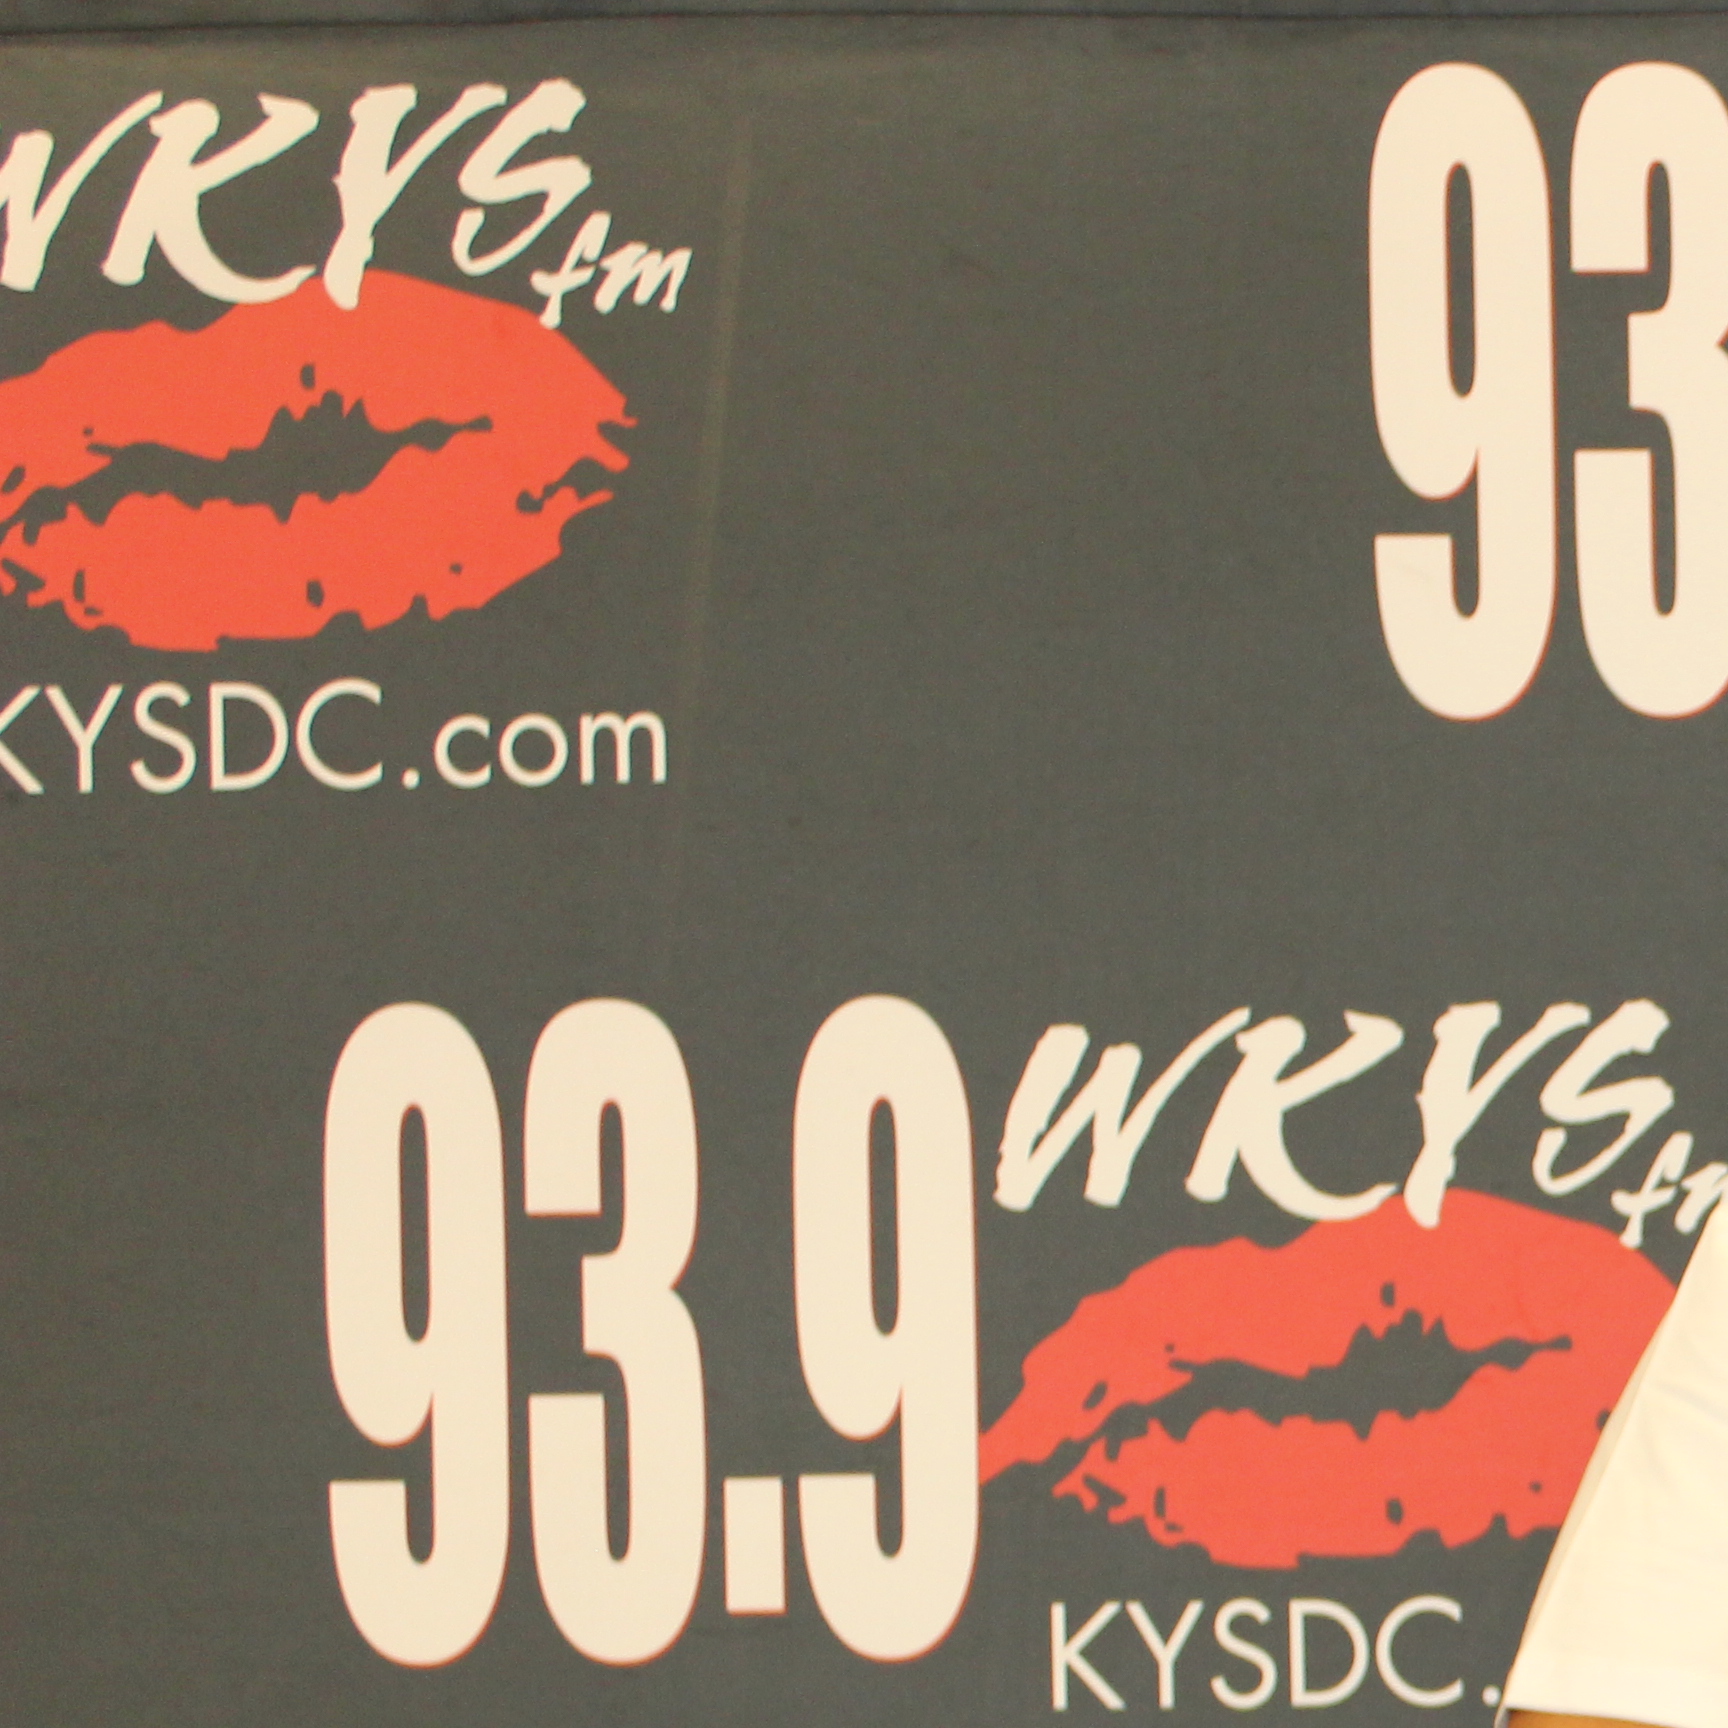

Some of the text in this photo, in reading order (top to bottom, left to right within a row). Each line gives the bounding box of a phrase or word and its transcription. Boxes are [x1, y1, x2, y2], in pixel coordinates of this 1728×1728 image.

[531, 213, 691, 328] fm
[995, 1001, 1673, 1228] WKYS
[325, 997, 978, 1663] 93.9
